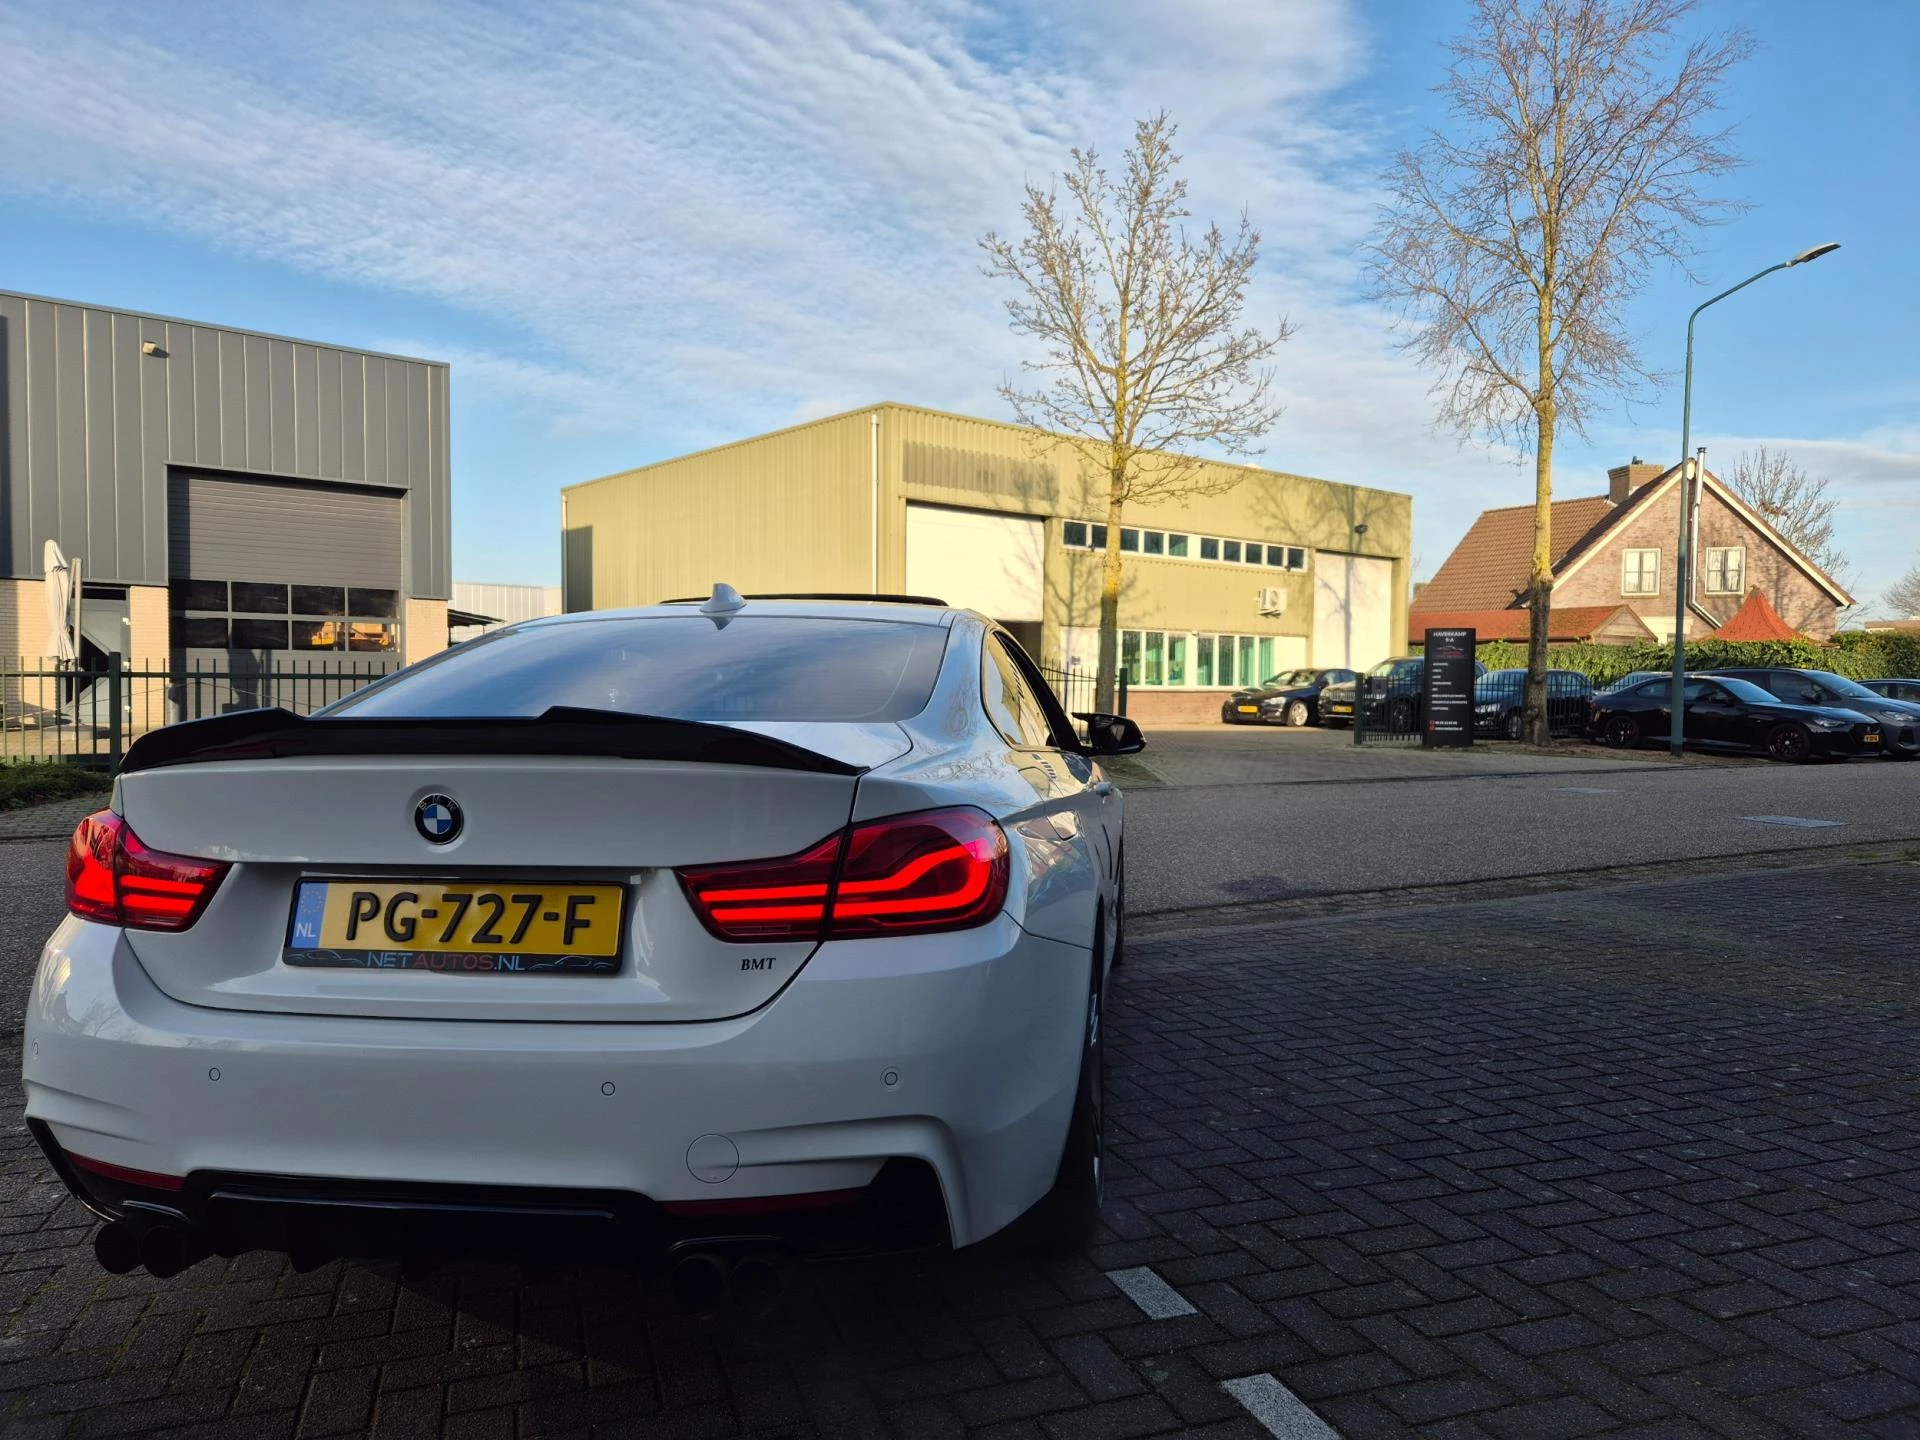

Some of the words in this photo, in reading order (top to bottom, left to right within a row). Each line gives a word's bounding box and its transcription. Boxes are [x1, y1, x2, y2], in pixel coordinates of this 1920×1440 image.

[346, 891, 595, 946] PG-727-F
[296, 921, 316, 938] NL
[741, 957, 777, 971] BMT
